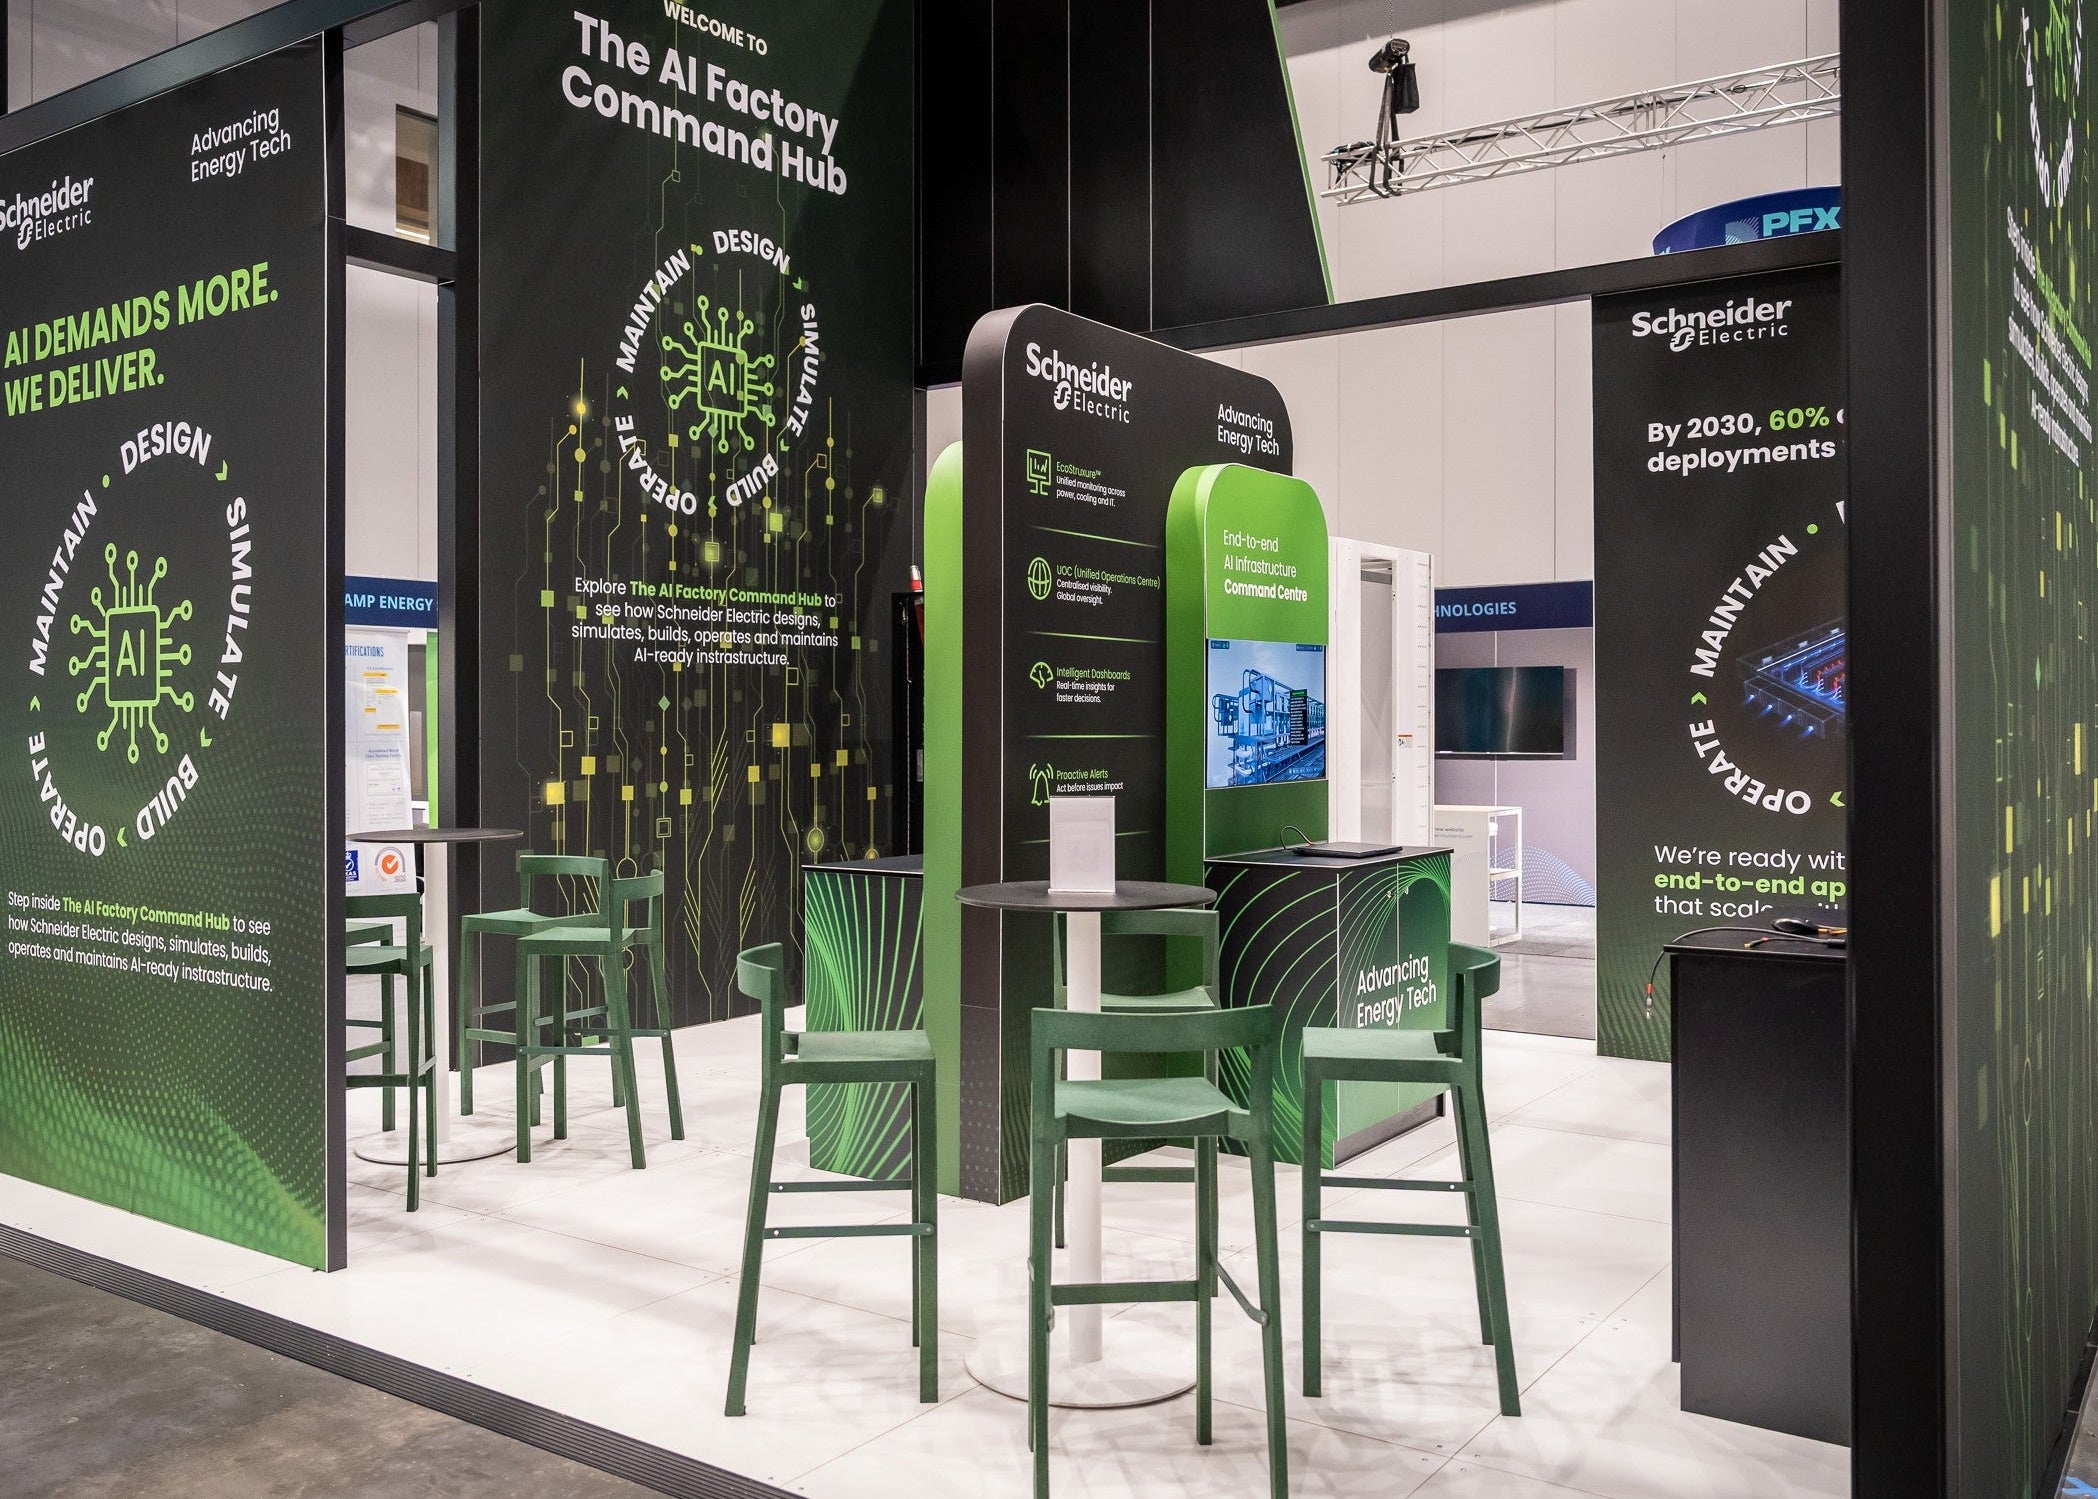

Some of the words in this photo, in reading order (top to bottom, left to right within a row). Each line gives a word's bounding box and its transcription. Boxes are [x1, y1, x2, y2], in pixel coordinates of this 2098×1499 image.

[664, 0, 743, 48] WELCOME
[746, 33, 768, 55] TO
[574, 11, 650, 76] The
[658, 48, 698, 96] AI
[707, 63, 840, 155] Factory
[191, 108, 280, 155] Advancing
[562, 66, 773, 172] Command
[781, 146, 847, 195] Hub
[191, 146, 245, 182] Energy
[250, 130, 291, 161] Tech
[35, 208, 92, 240] Electric
[1763, 206, 1841, 237] PFX
[713, 229, 791, 275] DESIGN
[4, 328, 28, 369] AI
[36, 290, 170, 361] DEMANDS
[178, 261, 279, 325] MORE.
[616, 249, 690, 373] MAINTAIN
[1632, 297, 1792, 337] Schneider
[1700, 324, 1788, 346] Electric
[5, 377, 43, 417] WE
[49, 348, 165, 408] DELIVER.
[708, 360, 735, 395] AI
[786, 303, 819, 438] SIMULATE
[1026, 342, 1133, 403] Schneider
[1073, 391, 1130, 424] Electric
[1218, 404, 1273, 438] Advancing
[1648, 422, 1681, 447] By
[1687, 413, 1762, 439] 2030,
[1769, 406, 1830, 431] 60%
[120, 421, 212, 475] DESIGN
[1218, 425, 1252, 454] Energy
[1256, 435, 1280, 456] Tech
[1648, 438, 1836, 476] deployments
[615, 415, 697, 515] OPERATE
[726, 453, 779, 507] BUILD
[1056, 475, 1077, 488] Unified
[1078, 481, 1107, 496] monitoring
[1108, 487, 1126, 498] across
[1056, 488, 1076, 501] power,
[1076, 493, 1097, 506] cooling
[1098, 496, 1108, 506] and
[1224, 529, 1279, 553] End-to-end
[29, 489, 99, 676] MAINTAIN
[1056, 565, 1073, 577] UOC
[1074, 564, 1100, 580] (Unified
[1101, 571, 1136, 585] Operations
[1137, 576, 1161, 590] Centre)
[1224, 554, 1233, 570] AI
[1236, 556, 1297, 578] Infrastructure
[380, 596, 434, 611] ENERGY
[575, 577, 627, 597] Explore
[630, 581, 656, 597] The
[659, 583, 673, 598] AI
[676, 583, 727, 606] Factory
[730, 588, 796, 605] Command
[799, 592, 822, 607] Hub
[824, 594, 836, 608] to
[1056, 579, 1089, 592] Centralised
[1090, 583, 1113, 596] visibility.
[1056, 591, 1076, 602] Global
[1076, 594, 1104, 606] oversight.
[1224, 578, 1276, 600] Command
[1278, 585, 1308, 602] Centre
[1690, 534, 1799, 677] MAINTAIN
[207, 496, 253, 721] SIMULATE
[596, 603, 621, 617] see
[624, 602, 654, 618] how
[658, 604, 723, 622] Schneider
[726, 608, 770, 624] Electric
[773, 610, 821, 631] designs,
[115, 629, 146, 677] AI
[572, 622, 645, 643] simulates,
[648, 625, 691, 645] builds,
[694, 630, 751, 647] operates
[754, 631, 778, 645] and
[781, 631, 838, 647] maintains
[634, 648, 693, 667] AI-ready
[696, 648, 790, 666] instrastructure.
[1056, 667, 1090, 681] Intelligent
[1092, 669, 1131, 680] Dashboards
[1056, 680, 1085, 691] Real-time
[1086, 681, 1107, 694] insights
[1107, 682, 1116, 692] for
[1056, 692, 1074, 702] faster
[1056, 769, 1089, 780] Proactive
[1090, 768, 1109, 780] Alerts
[1689, 719, 1811, 815] OPERATE
[28, 731, 106, 857] OPERATE
[135, 753, 199, 840] BUILD
[1056, 783, 1067, 793] Act
[1067, 782, 1086, 792] before
[1086, 782, 1104, 792] issues
[1104, 781, 1124, 793] impact
[1729, 849, 1802, 874] ready
[1808, 850, 1846, 870] wit
[1654, 871, 1805, 895] end-to-end
[8, 891, 30, 909] Step
[32, 893, 61, 912] inside
[62, 897, 82, 914] The
[84, 899, 95, 916] AI
[97, 901, 138, 925] Factory
[140, 905, 203, 929] Command
[205, 913, 231, 931] Hub
[232, 915, 246, 933] to
[248, 919, 271, 936] see
[1654, 895, 1703, 916] that
[8, 915, 28, 932] how
[30, 917, 80, 938] Schneider
[82, 924, 120, 944] Electric
[122, 928, 167, 953] designs,
[170, 935, 229, 961] simulates,
[232, 942, 272, 967] builds,
[8, 941, 51, 959] operates
[54, 945, 74, 963] and
[76, 949, 128, 971] maintains
[130, 956, 180, 983] AI-ready
[182, 962, 273, 992] instrastructure.
[1357, 953, 1429, 996] Advancing
[1358, 993, 1404, 1029] Energy
[1407, 980, 1437, 1010] Tech
